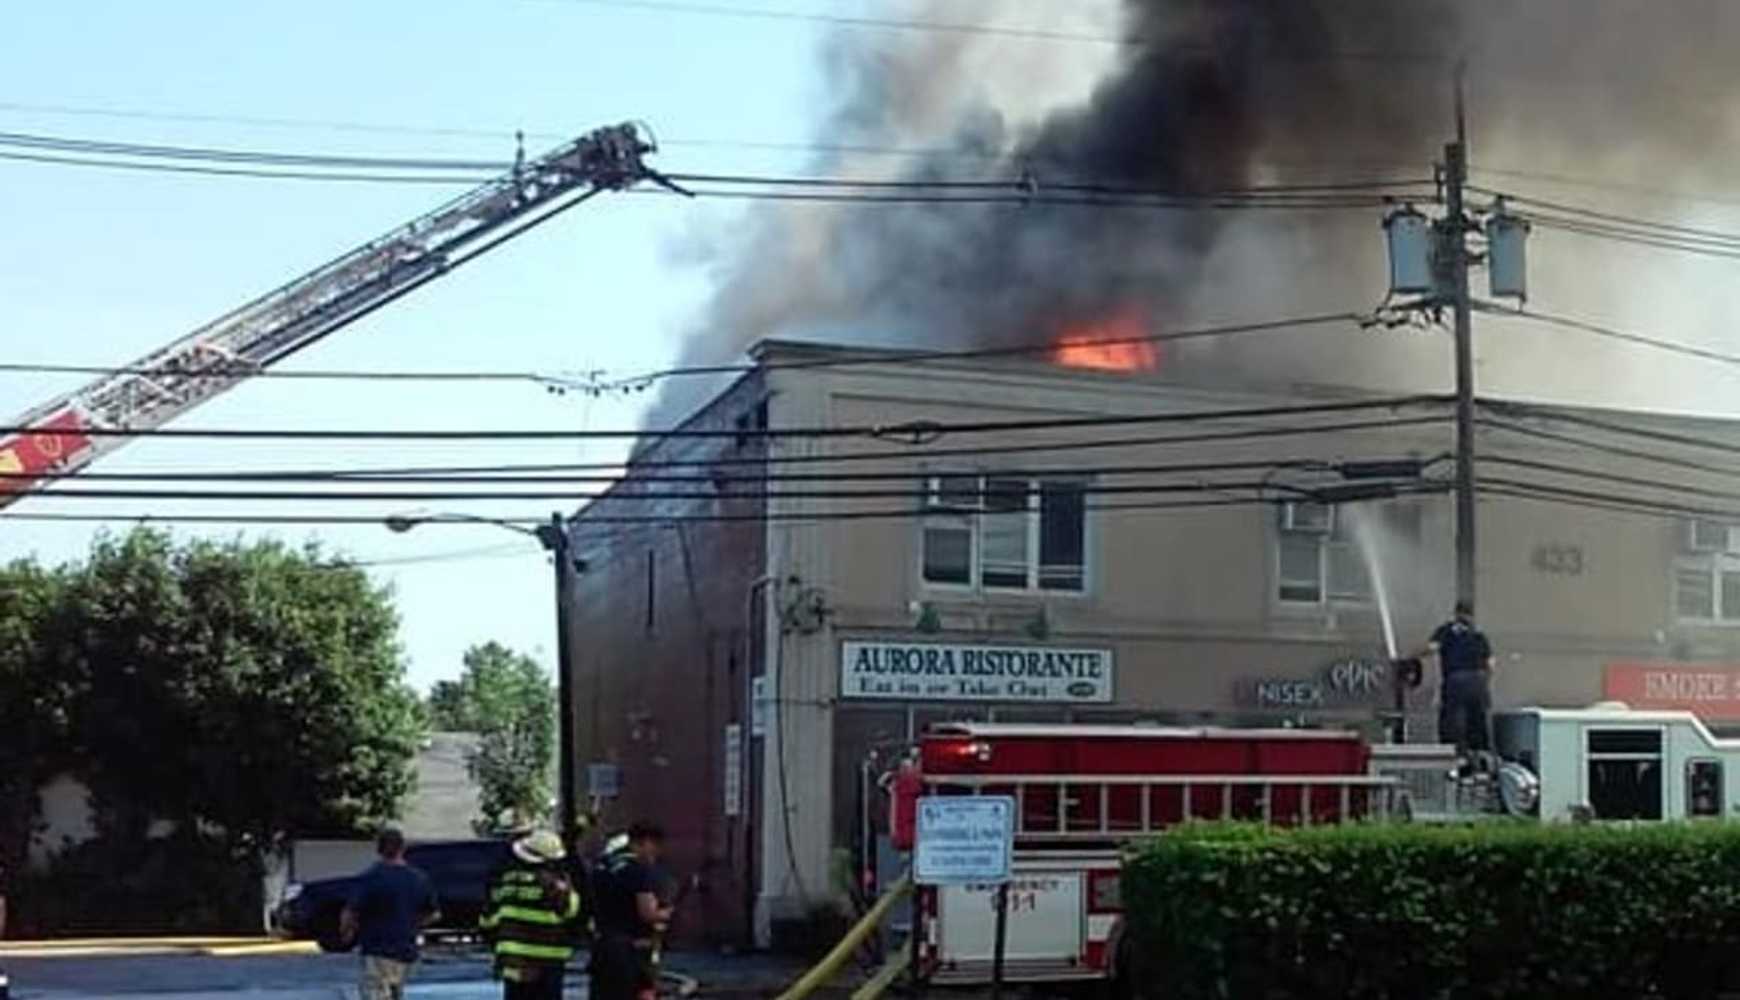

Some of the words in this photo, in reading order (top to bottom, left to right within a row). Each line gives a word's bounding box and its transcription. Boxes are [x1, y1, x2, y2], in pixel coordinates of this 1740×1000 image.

[854, 648, 955, 675] AURORA
[963, 650, 1102, 679] RISTORANTE
[859, 677, 892, 693] Eat
[957, 678, 999, 696] Take
[1007, 680, 1048, 697] Out
